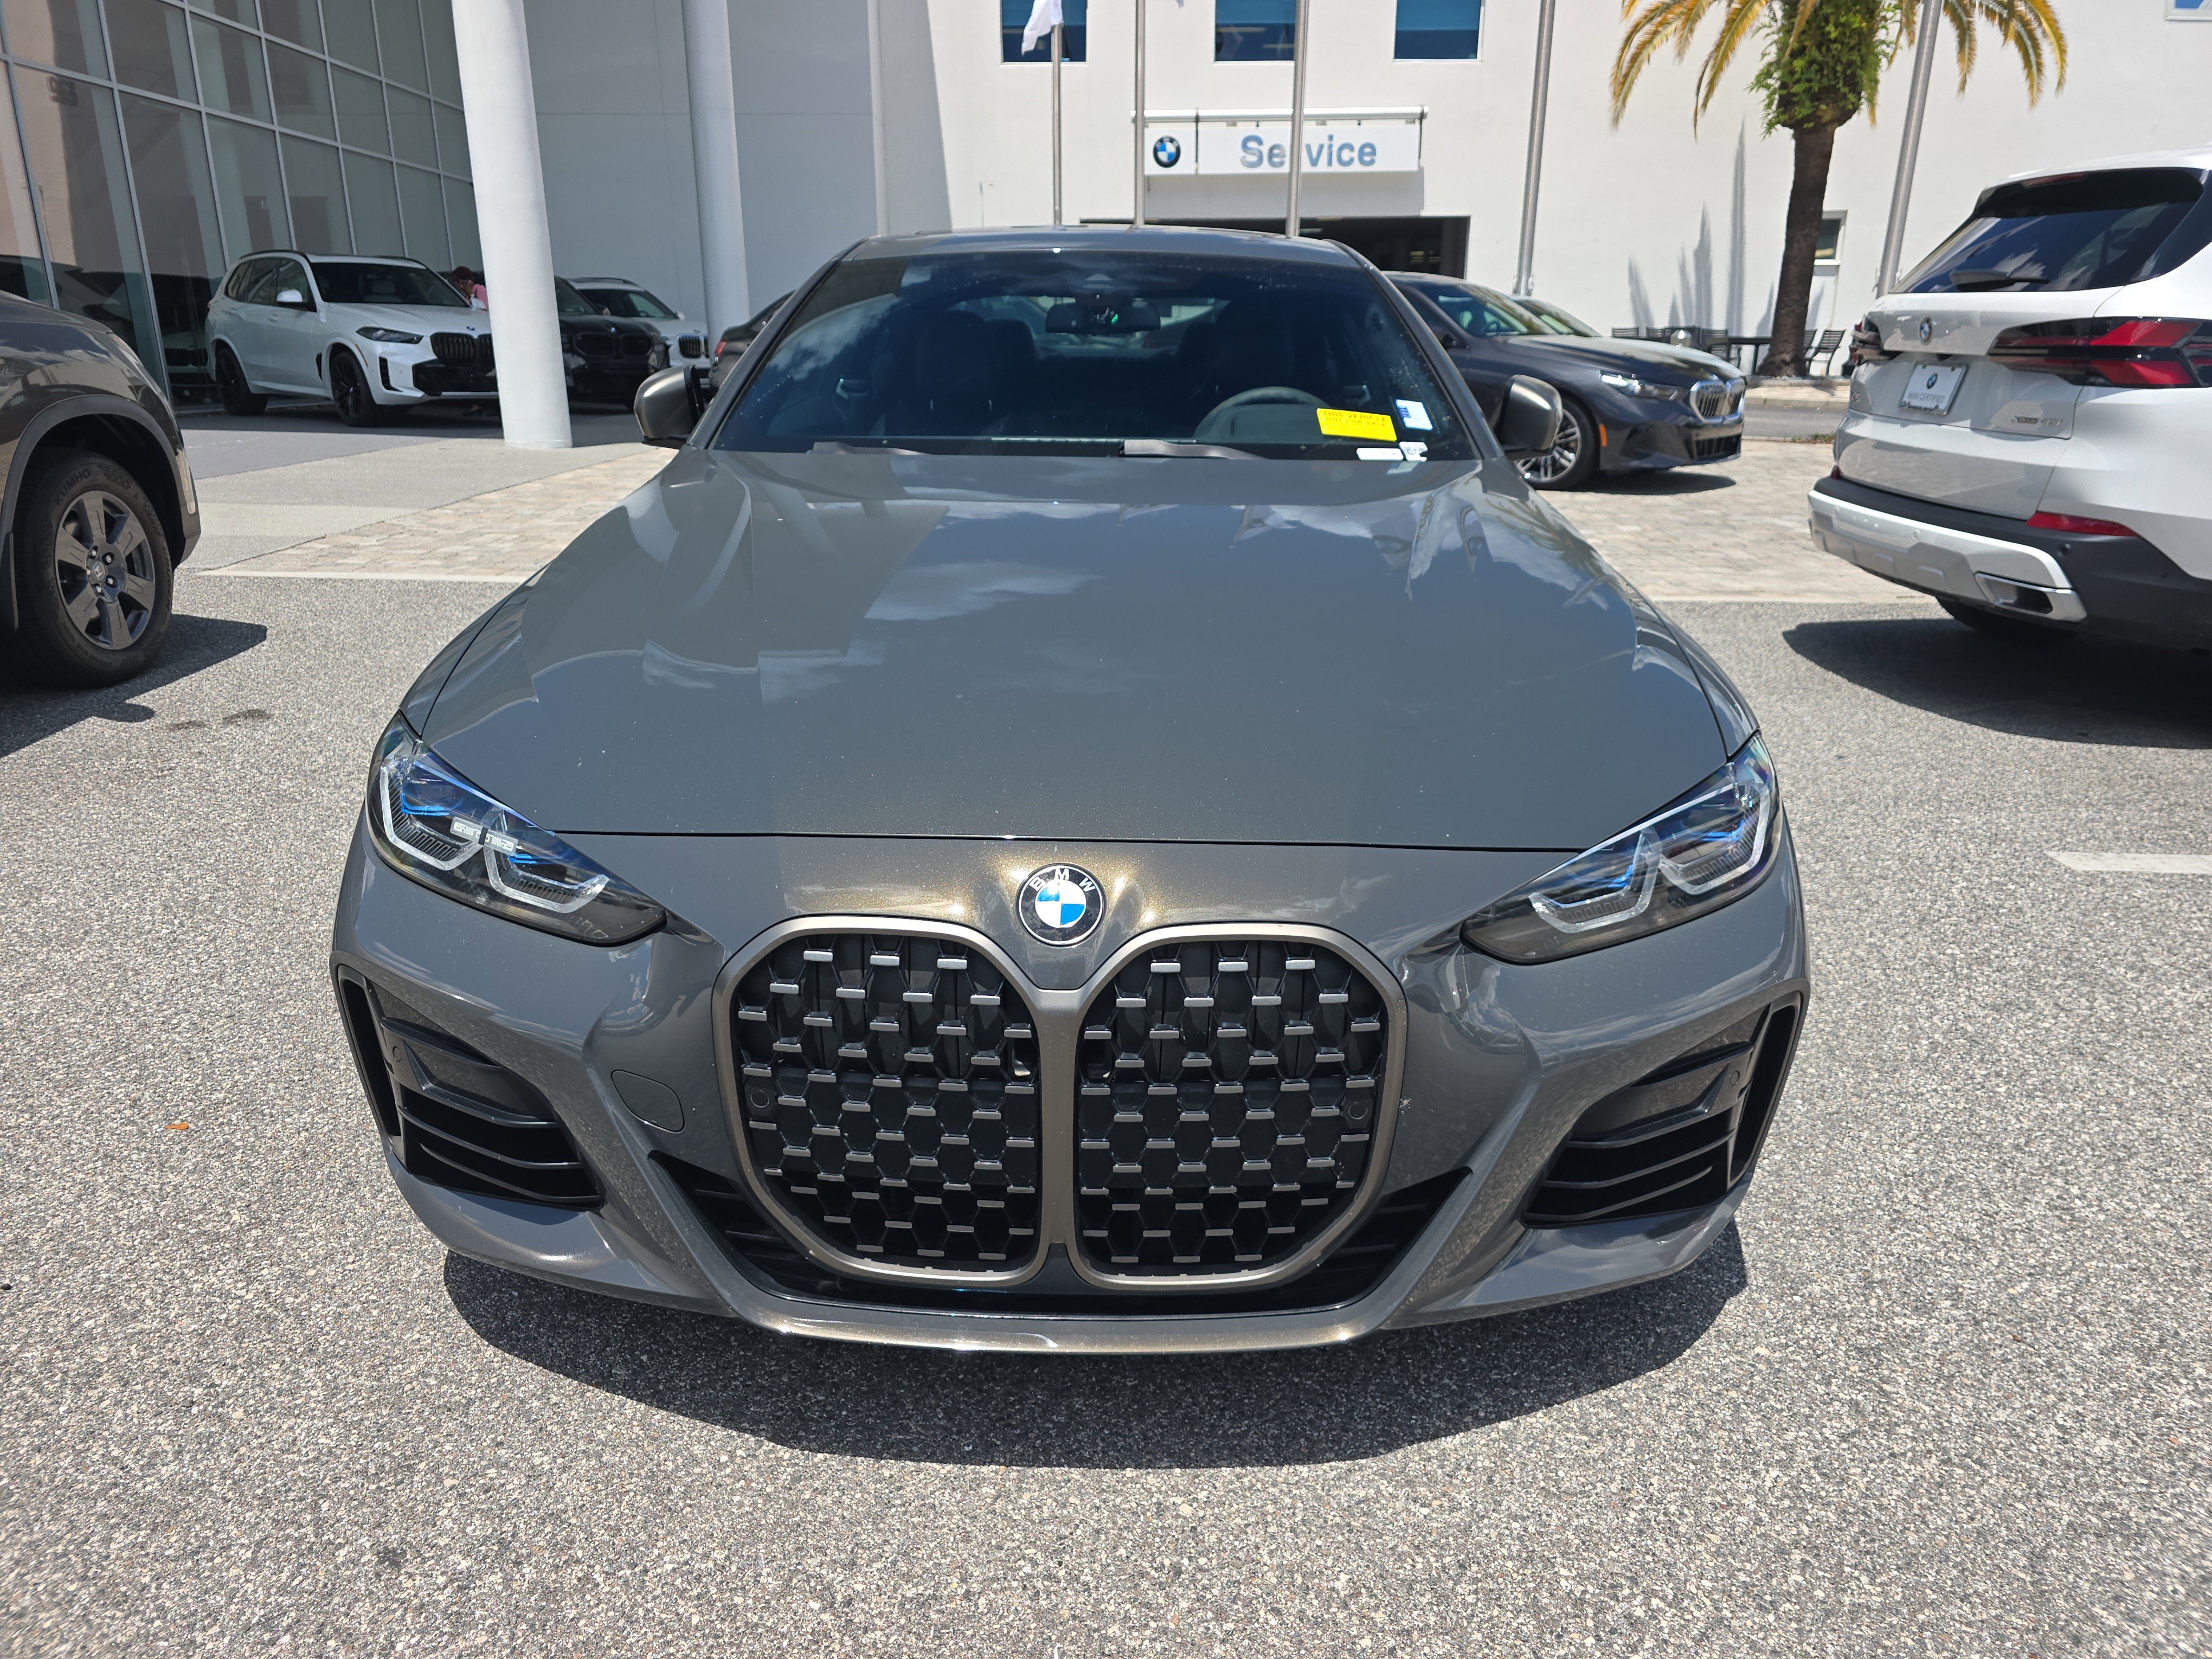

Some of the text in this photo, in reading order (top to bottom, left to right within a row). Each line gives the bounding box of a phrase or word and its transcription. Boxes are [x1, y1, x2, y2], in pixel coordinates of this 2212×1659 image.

[1240, 133, 1377, 168] Sevice
[54, 468, 91, 506] KUMHO
[1029, 867, 1096, 892] BMW
